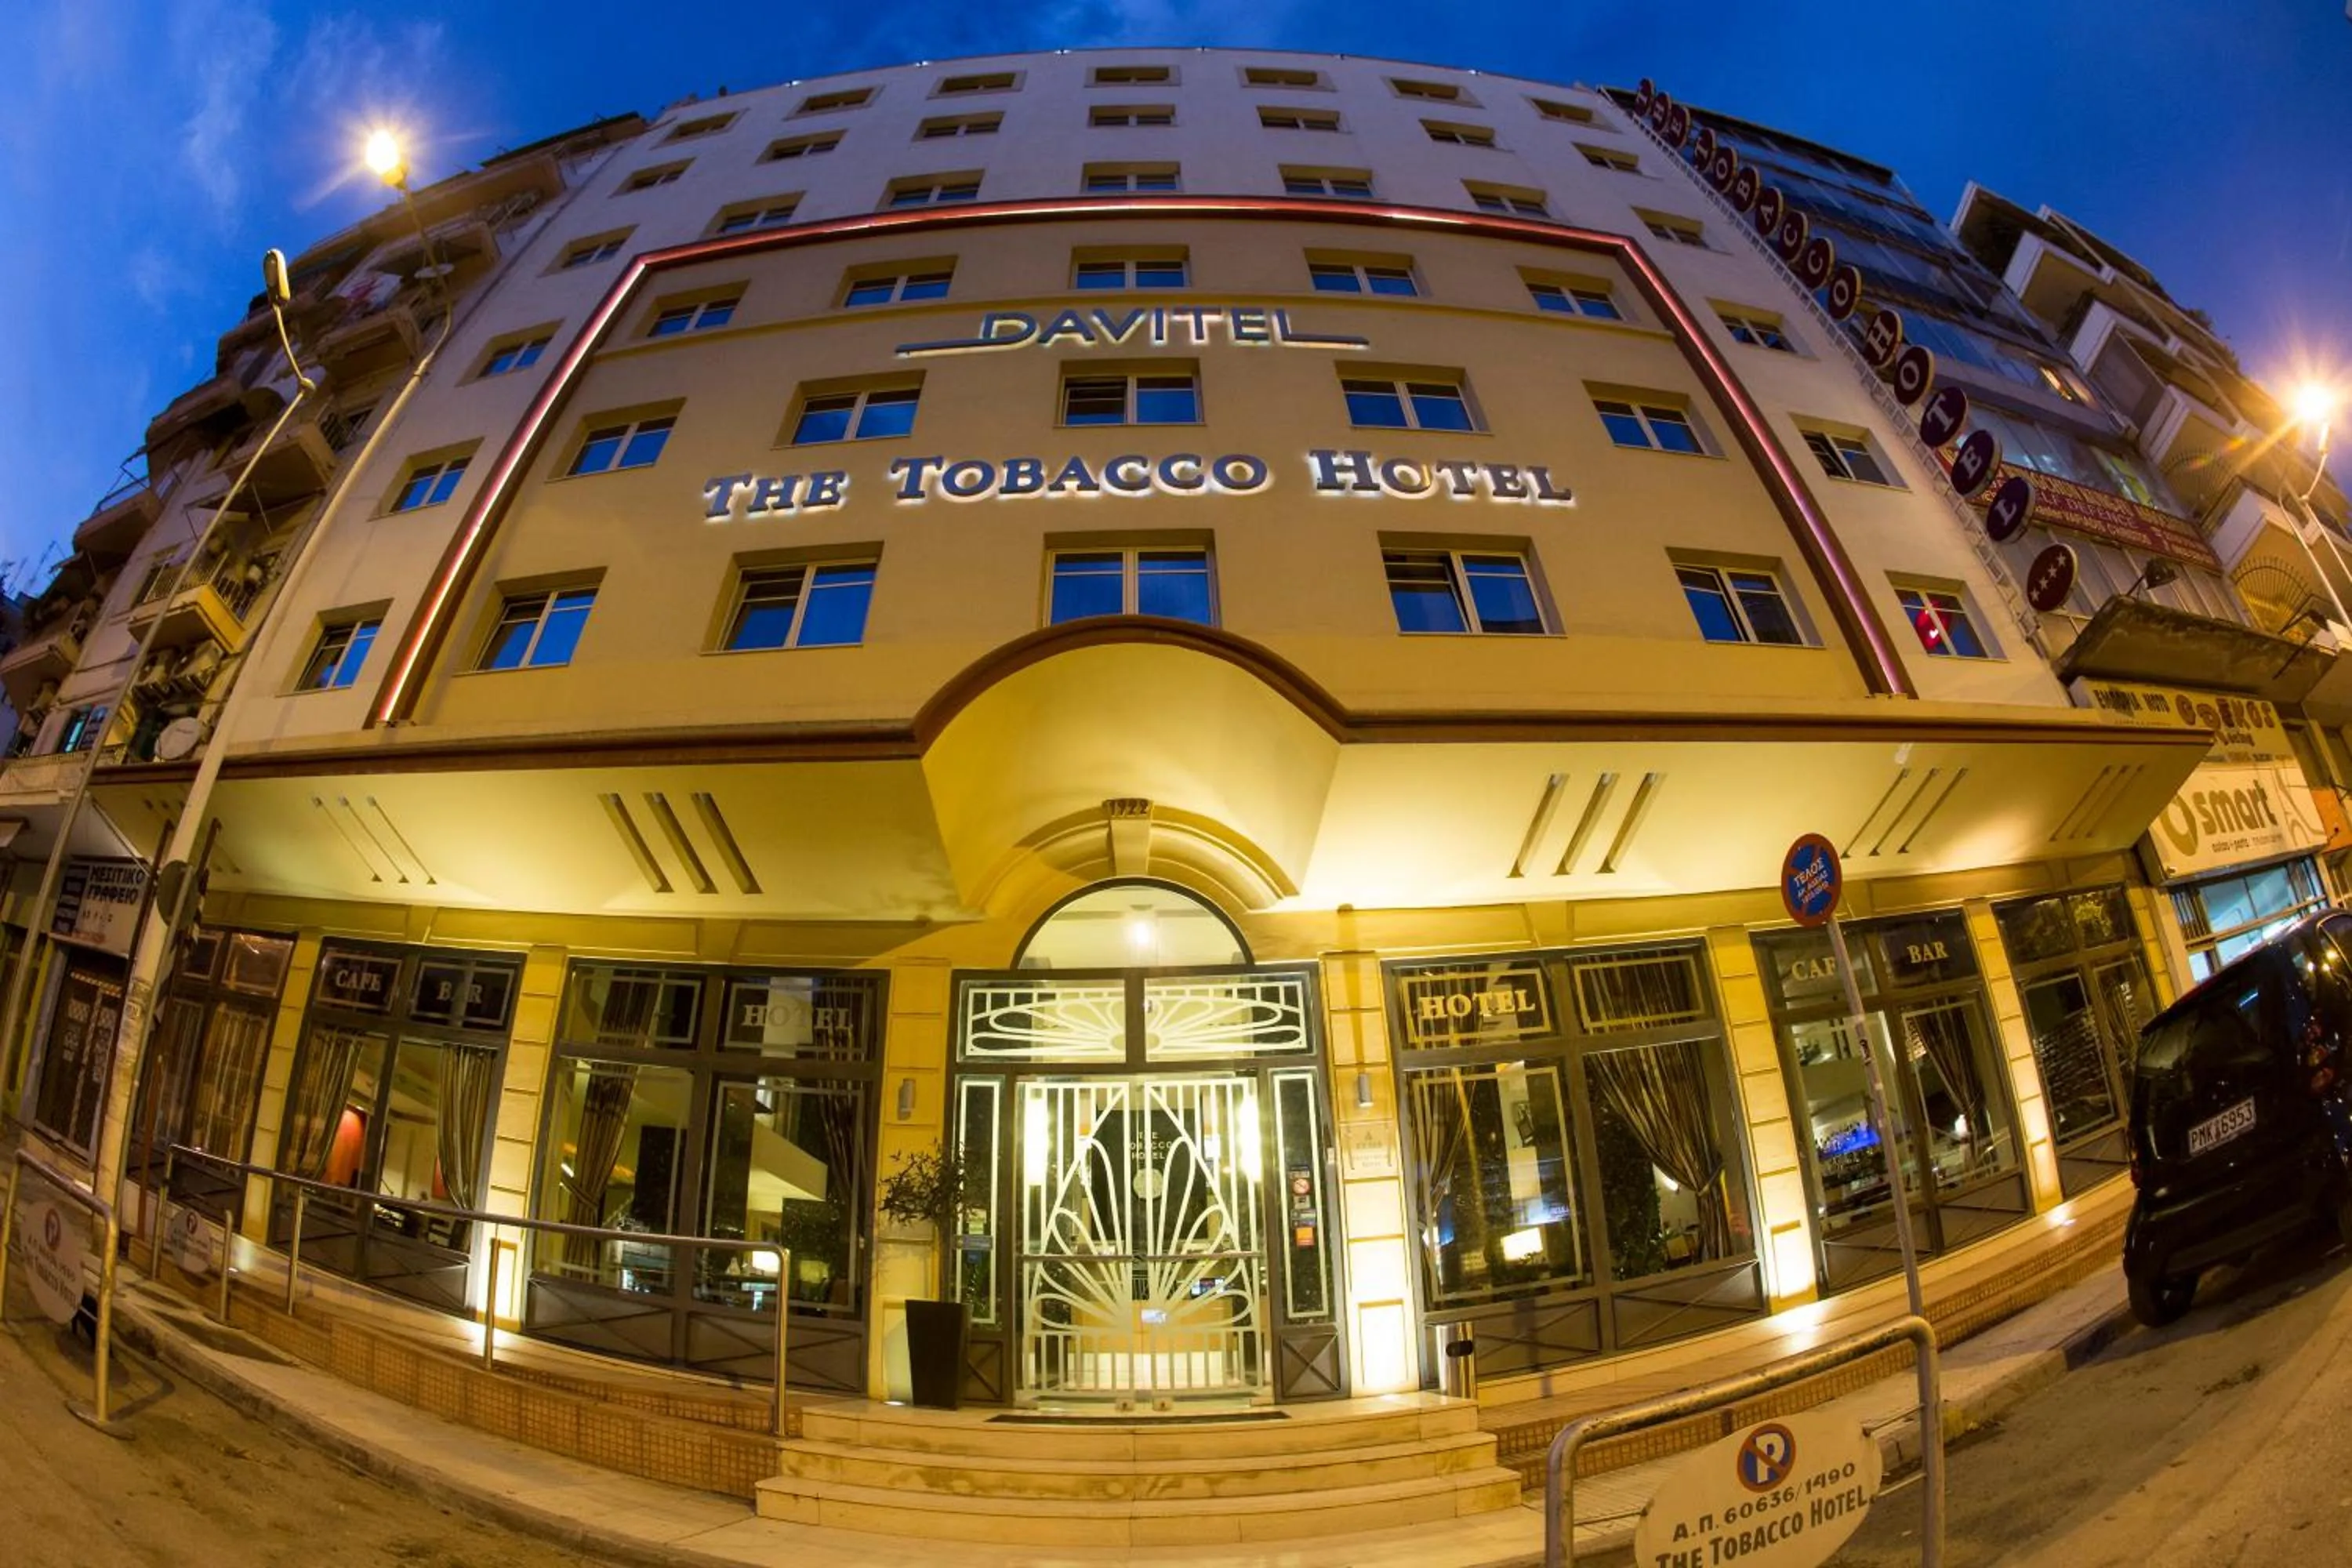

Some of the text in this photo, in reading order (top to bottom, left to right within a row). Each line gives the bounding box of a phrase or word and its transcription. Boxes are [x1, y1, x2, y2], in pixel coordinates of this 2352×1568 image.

[960, 303, 1334, 356] DAVITEL
[1636, 85, 2016, 527] THE TOBACCO HOTEL
[888, 452, 1270, 502] TOBACCO
[1308, 448, 1576, 503] HOTEL
[1907, 941, 1950, 964] BAR
[1417, 989, 1536, 1019] HOTEL
[1724, 1462, 1856, 1525] 60636/1490
[1708, 1511, 1804, 1566] TOBACCO
